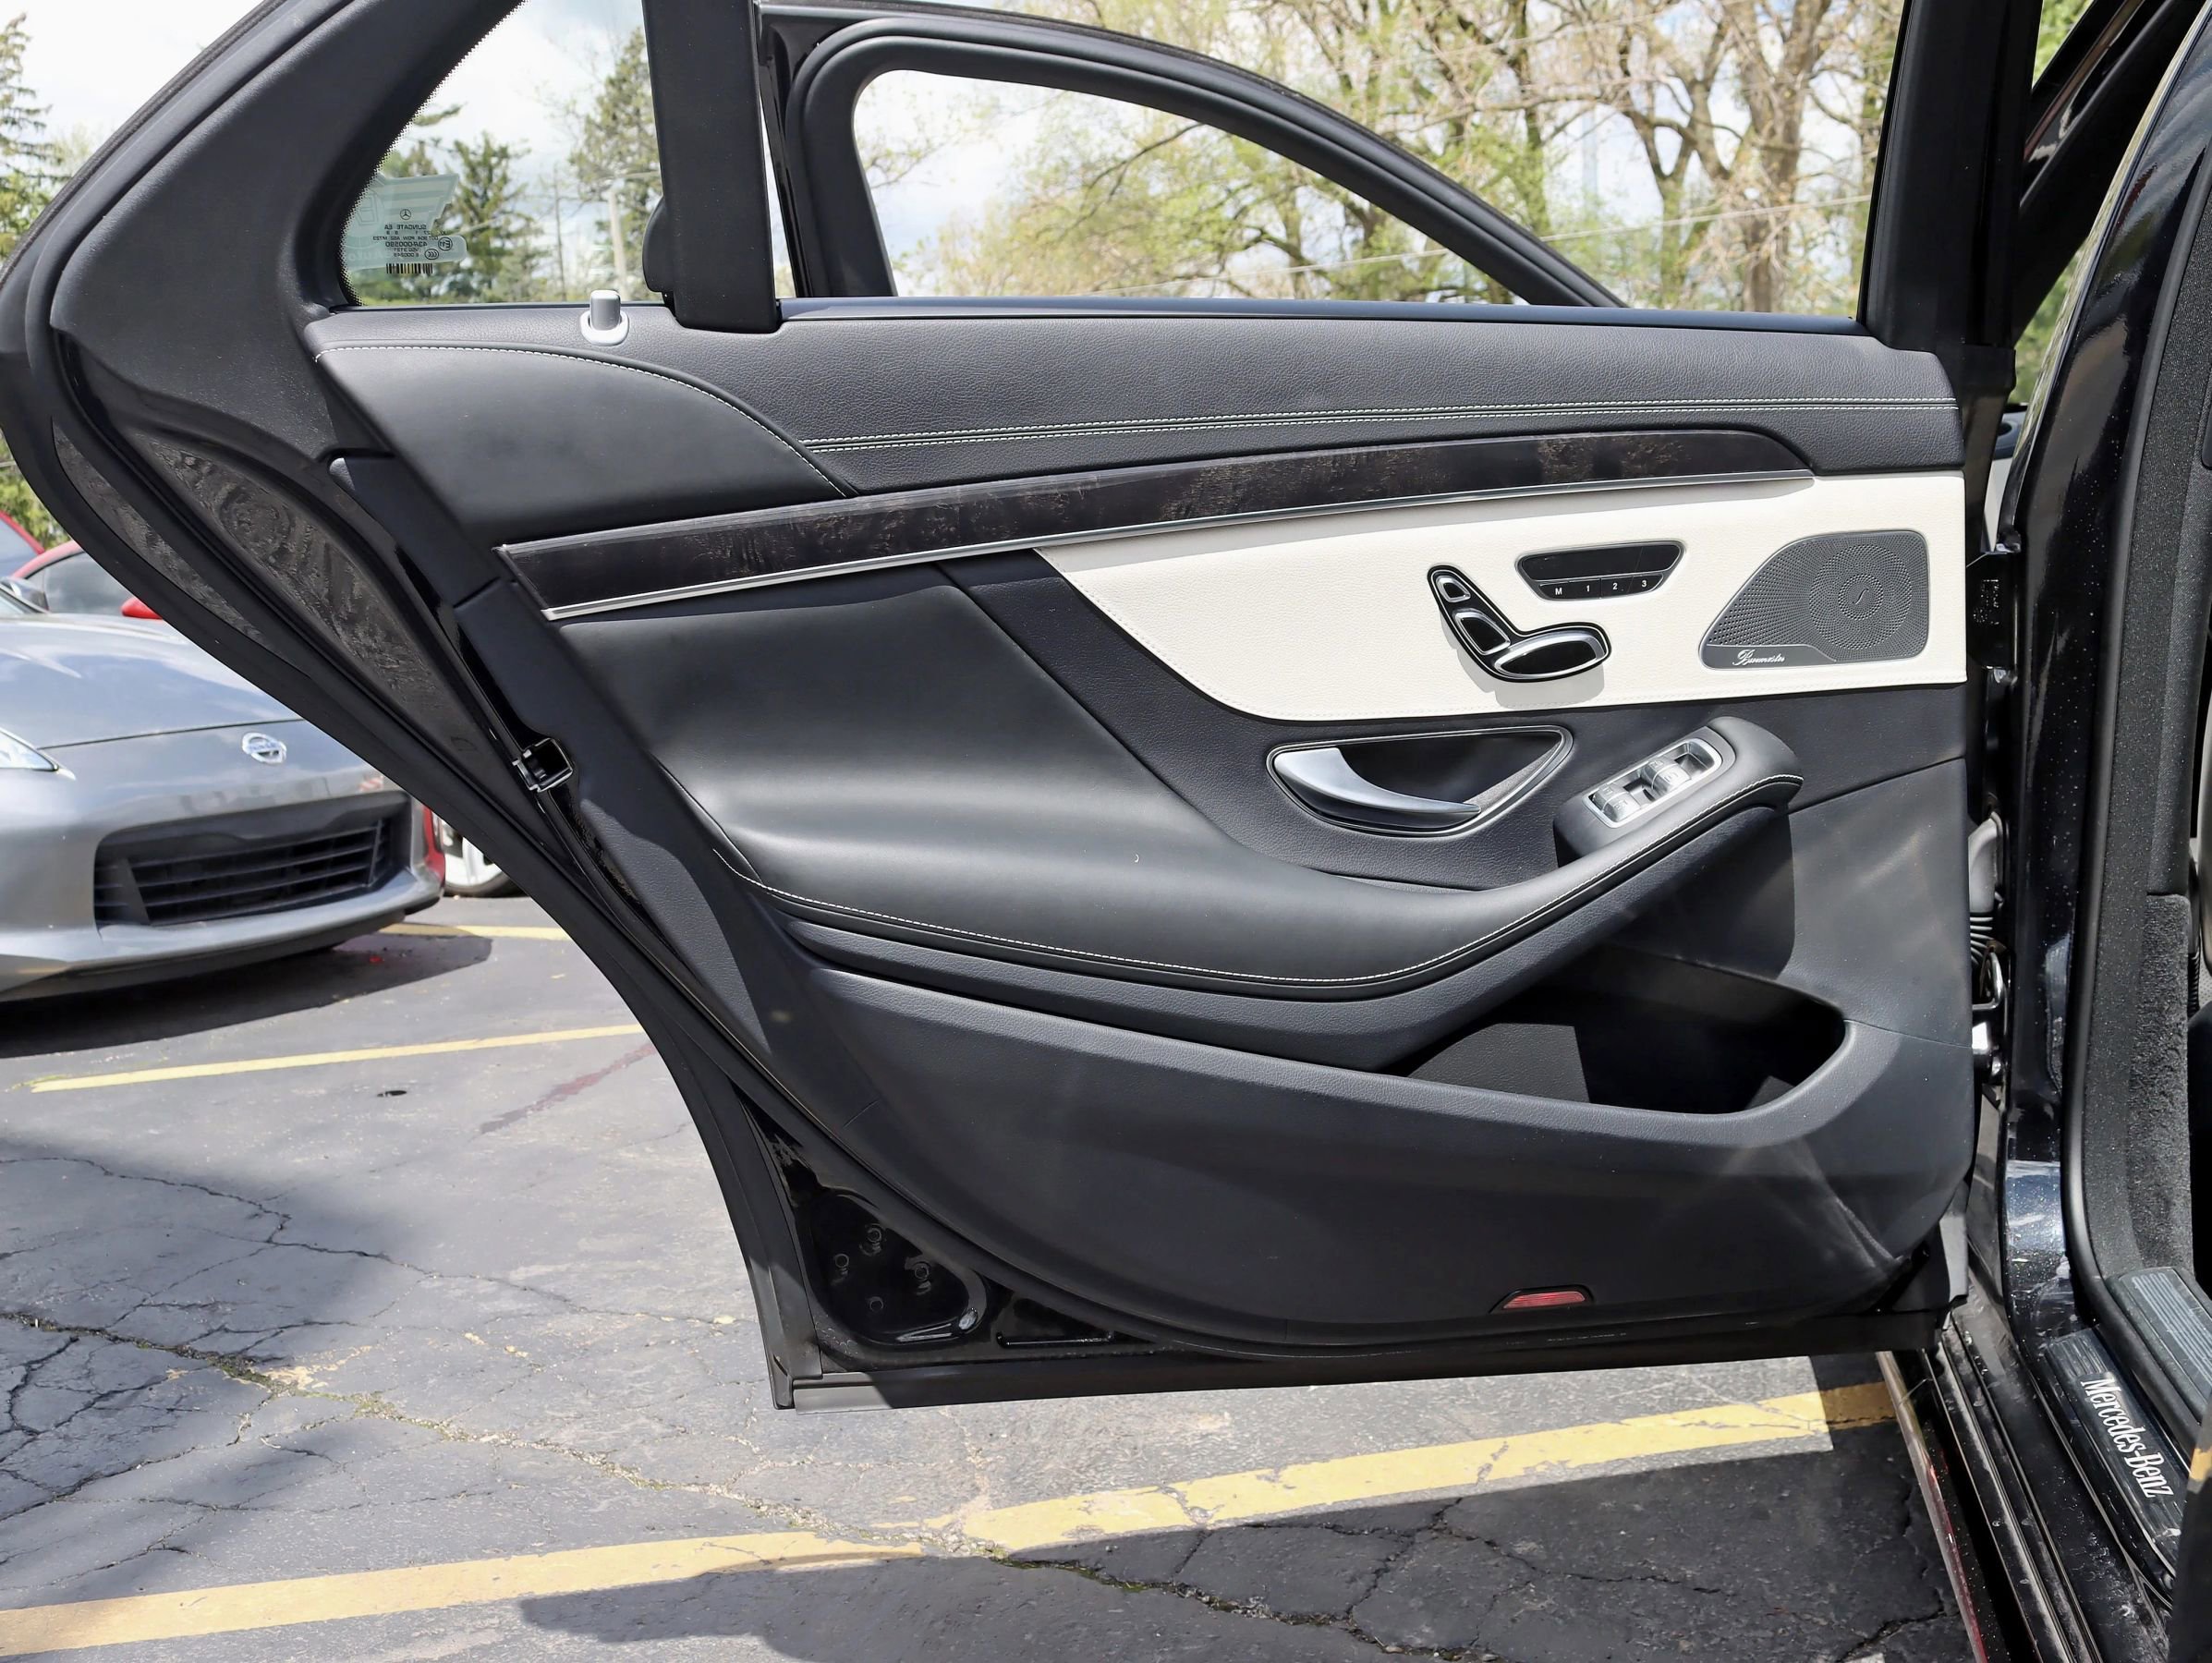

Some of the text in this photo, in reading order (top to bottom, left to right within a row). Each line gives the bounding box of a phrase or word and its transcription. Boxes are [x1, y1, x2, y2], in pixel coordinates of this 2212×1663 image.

[1555, 588, 1562, 596] M
[1612, 582, 1618, 590] 2
[1641, 579, 1647, 588] 3
[2080, 1378, 2174, 1499] Mercedes-Benz
